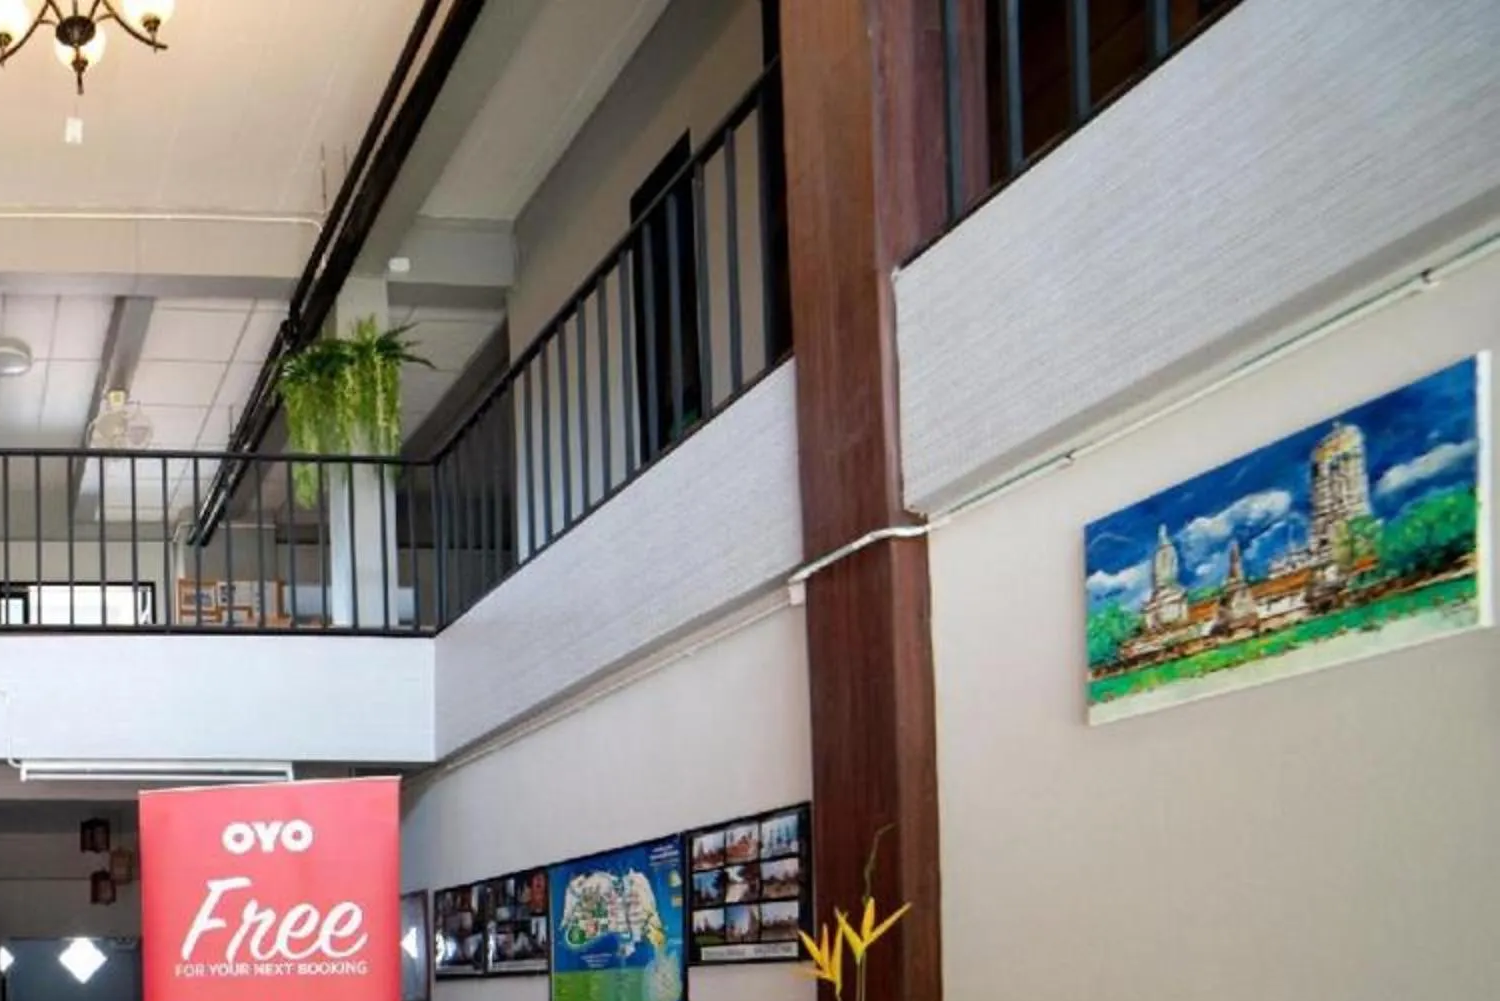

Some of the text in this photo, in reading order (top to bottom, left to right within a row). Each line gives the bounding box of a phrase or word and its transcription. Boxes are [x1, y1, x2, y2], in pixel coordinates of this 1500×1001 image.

[222, 819, 314, 854] OYO
[181, 876, 368, 964] Free
[175, 961, 367, 977] FOR YOUR NEXT BOOKING
